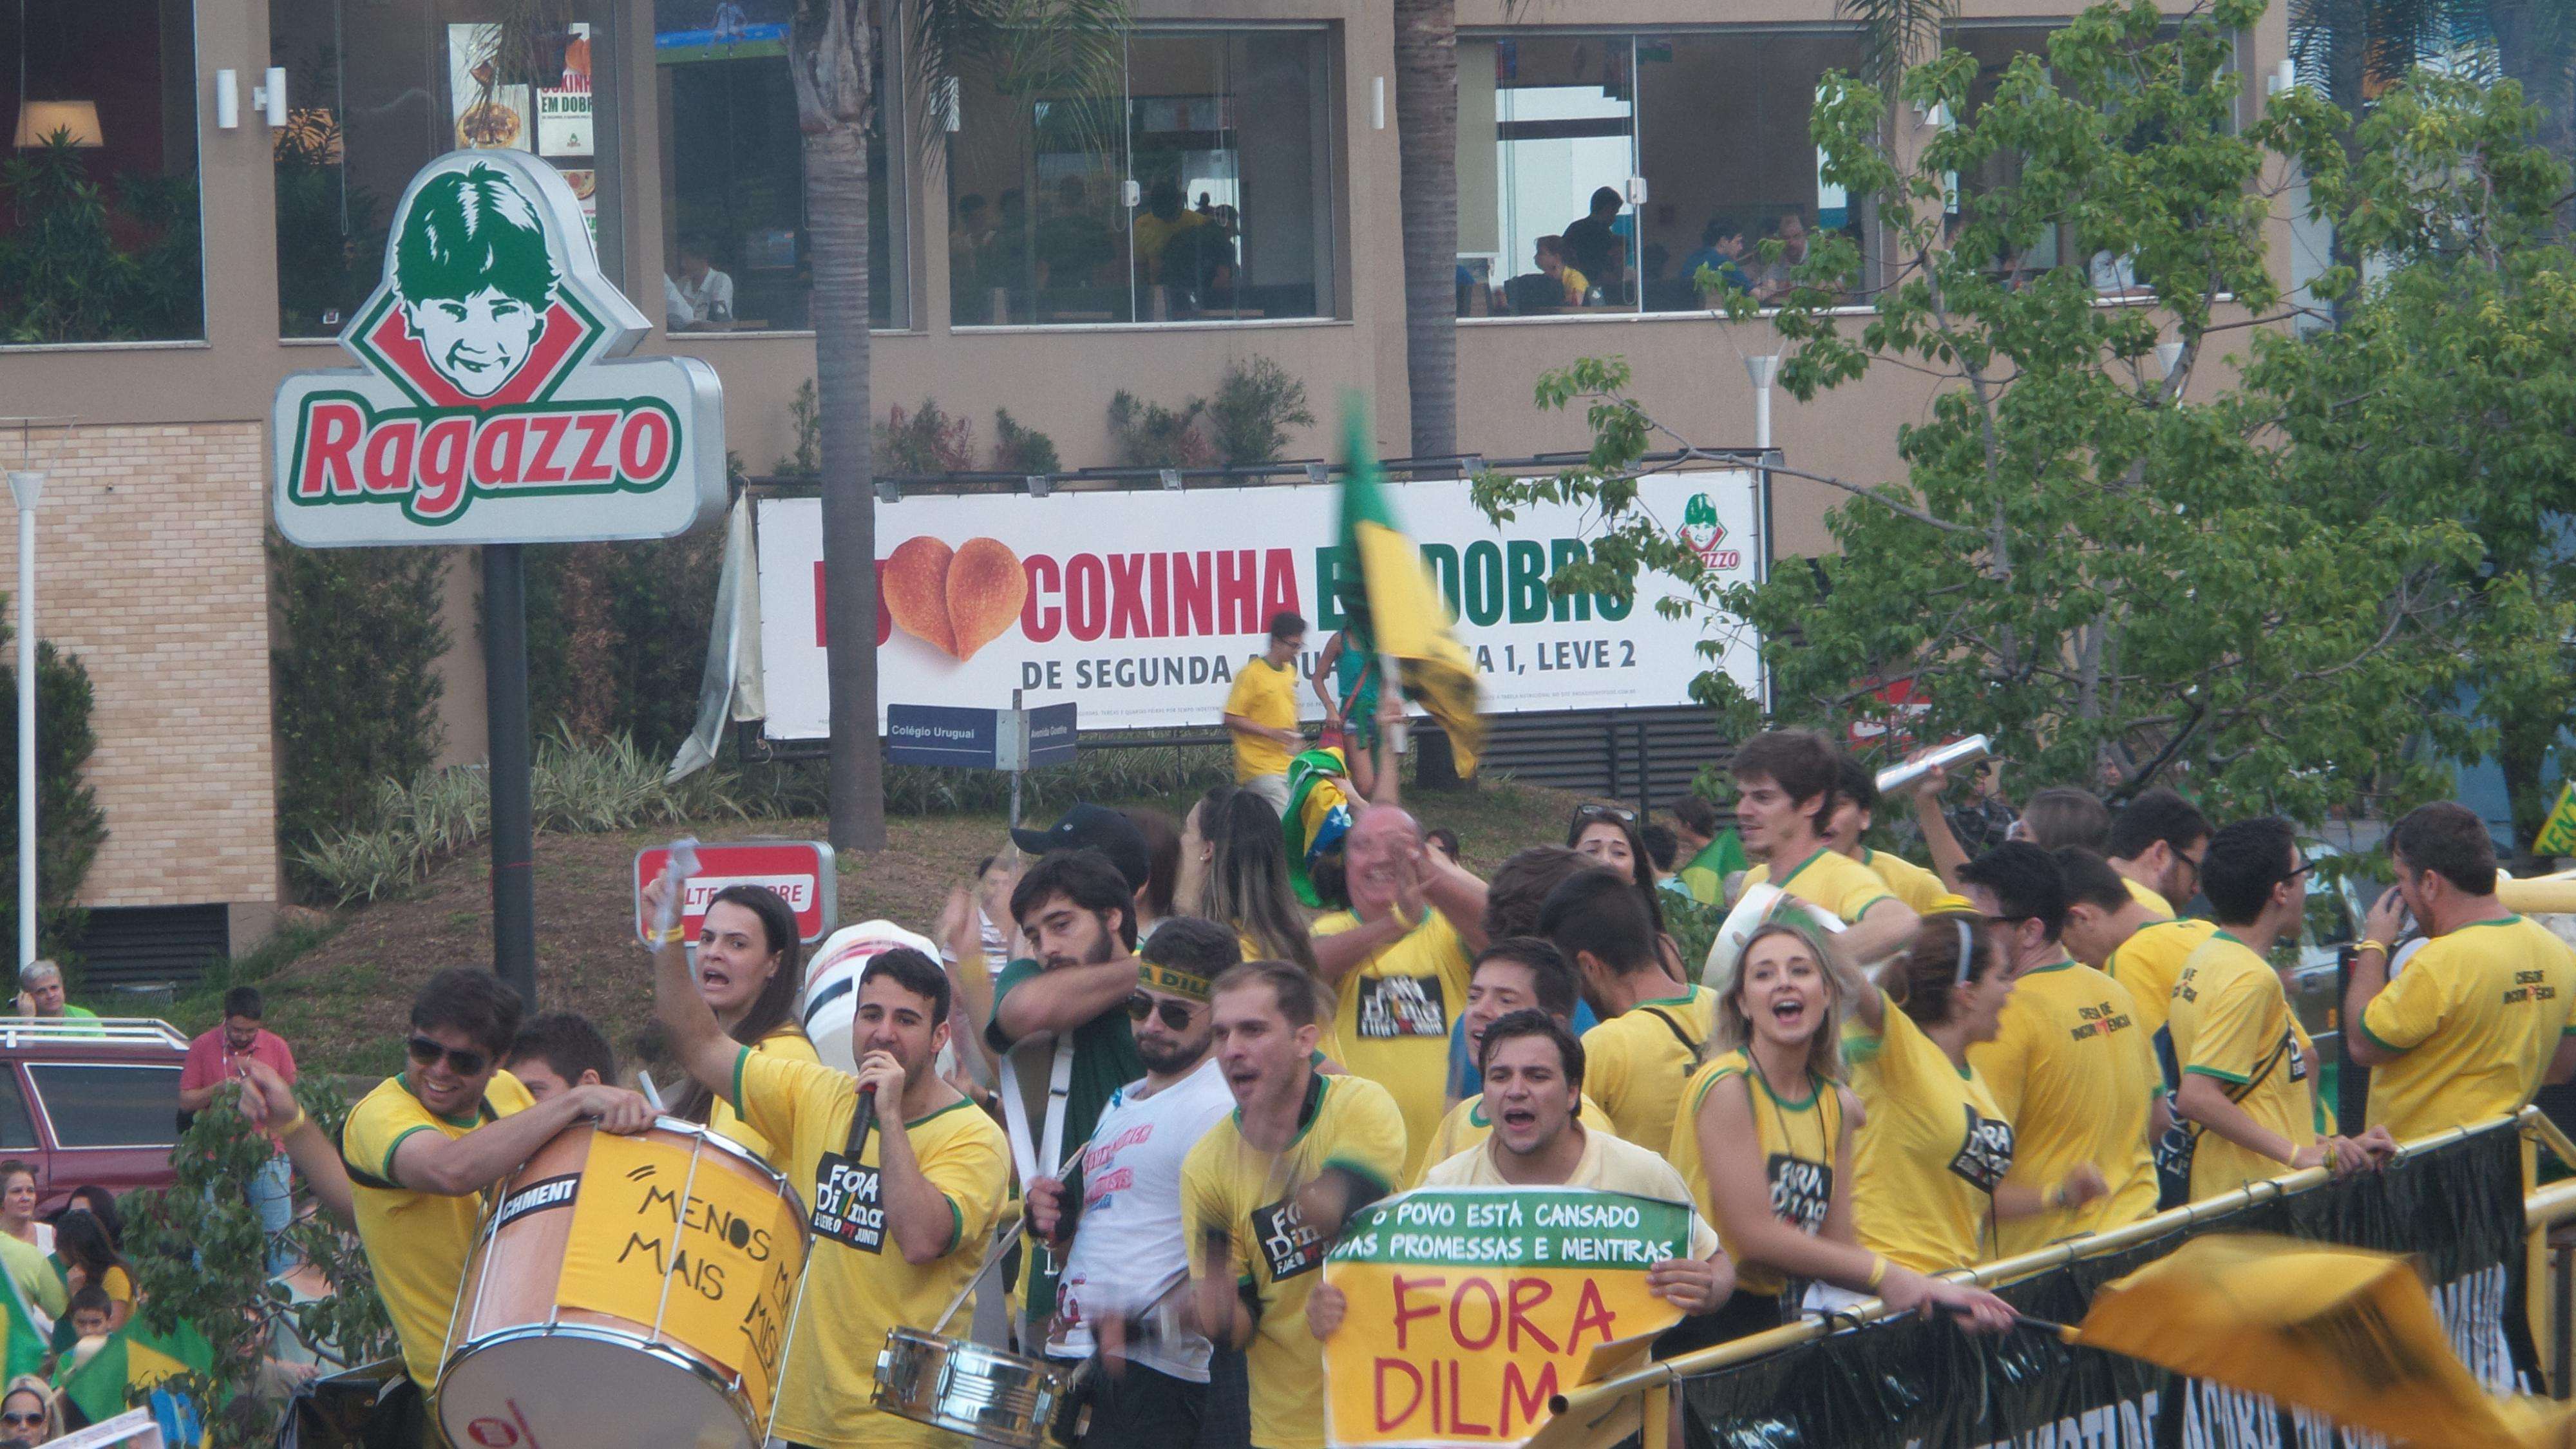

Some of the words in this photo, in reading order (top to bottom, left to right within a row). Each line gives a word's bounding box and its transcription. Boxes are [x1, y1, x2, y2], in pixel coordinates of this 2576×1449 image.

[542, 97, 558, 113] EM
[301, 404, 668, 513] Ragazzo
[1020, 547, 1302, 643] COXINHA
[1022, 660, 1063, 690] DE
[1076, 654, 1232, 689] SEGUNDA
[1537, 640, 1611, 672] LEVE
[1620, 639, 1636, 668] 2
[891, 724, 931, 738] Colégio
[934, 726, 974, 739] Uruguai
[1372, 1211, 1387, 1226] O
[1397, 1202, 1455, 1226] POVO
[1534, 1202, 1640, 1229] CANSADO
[618, 1232, 726, 1302] MAIS
[1390, 1233, 1522, 1262] PROMESSAS
[1535, 1236, 1549, 1260] E
[1561, 1237, 1674, 1263] MENTIRAS
[1392, 1274, 1616, 1356] FORA
[1374, 1356, 1560, 1438] DILM
